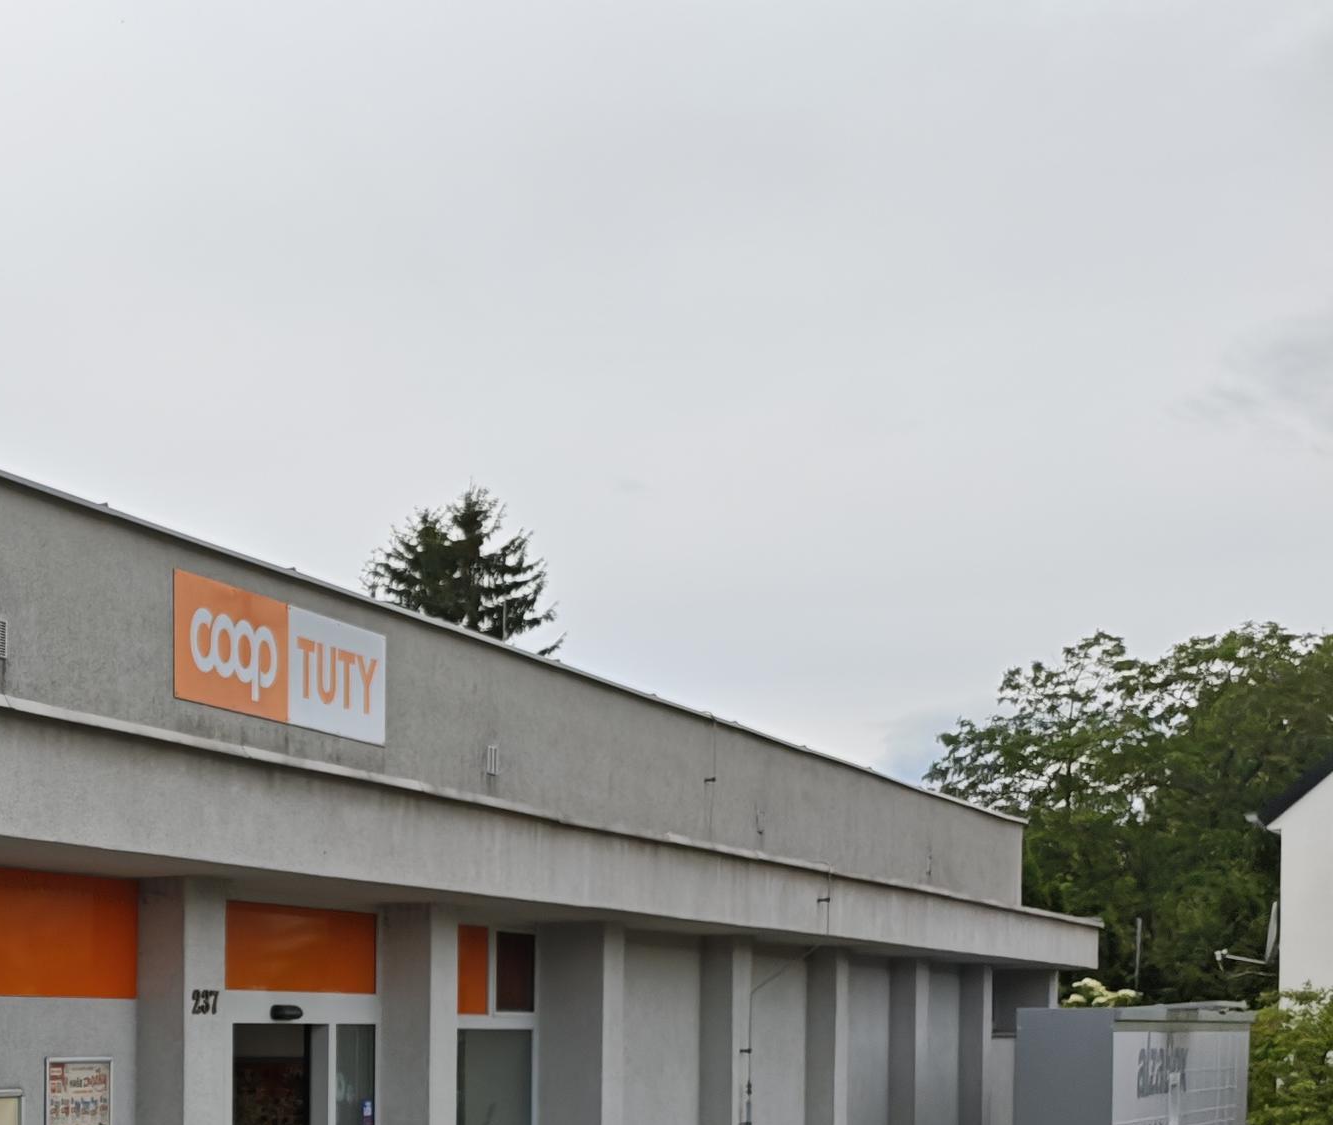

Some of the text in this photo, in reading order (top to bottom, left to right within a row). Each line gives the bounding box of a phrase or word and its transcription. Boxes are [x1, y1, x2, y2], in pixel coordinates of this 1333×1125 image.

[190, 607, 378, 715] coop TUTY
[191, 989, 219, 1015] 237
